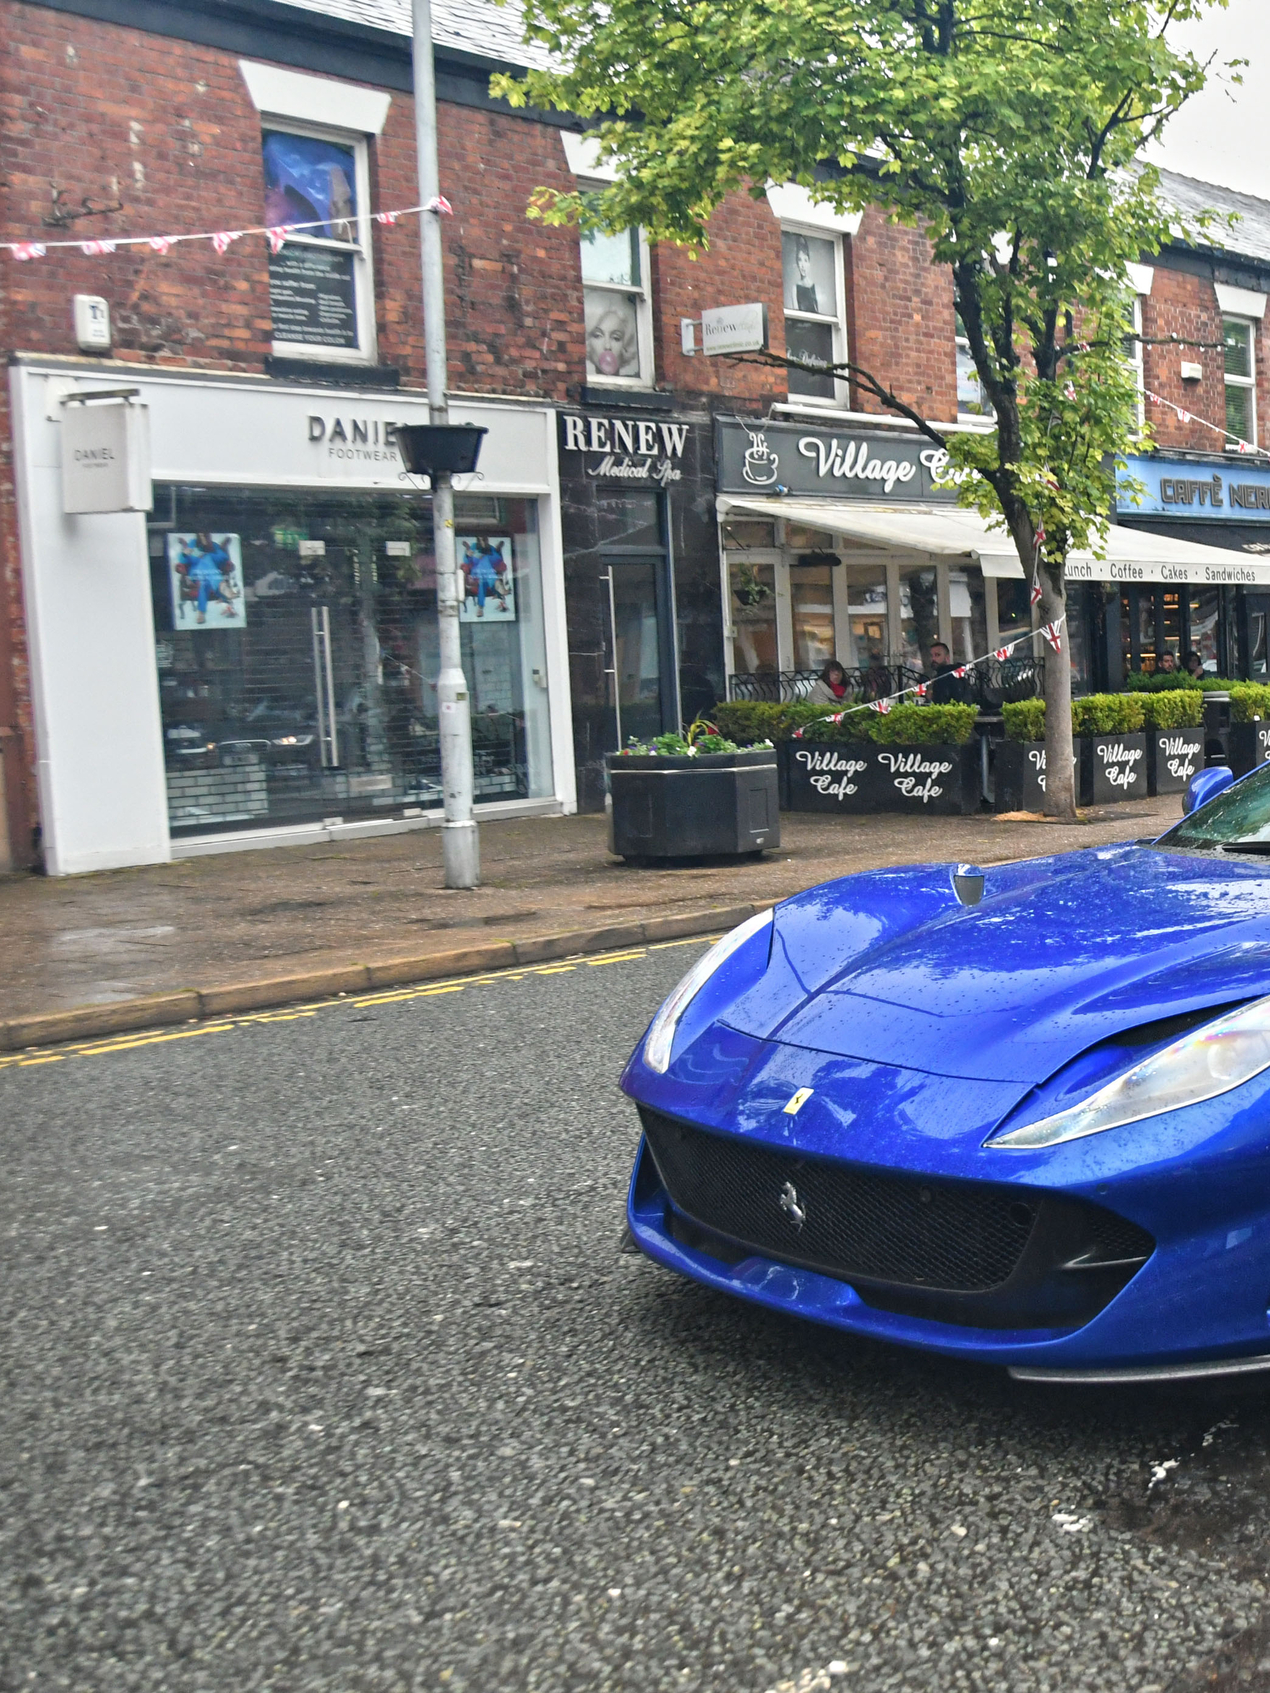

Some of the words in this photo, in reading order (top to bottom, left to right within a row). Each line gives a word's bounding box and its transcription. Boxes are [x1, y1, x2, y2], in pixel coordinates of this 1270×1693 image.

[307, 415, 402, 446] DANIE
[563, 415, 690, 459] RENEW
[75, 447, 115, 461] DANIEL
[328, 447, 398, 462] FOOTWEAR
[798, 437, 916, 494] Village
[587, 455, 649, 478] Medical
[652, 459, 682, 487] Spa
[1110, 562, 1144, 579] Coffee
[1161, 565, 1188, 580] Cakes
[1205, 567, 1256, 582] Sandwiches
[1097, 743, 1142, 767] Village
[1158, 736, 1201, 760] Village
[795, 750, 867, 777] Village
[877, 752, 952, 779] Village
[1167, 758, 1195, 782] Cafe
[809, 774, 858, 801] Cafe
[893, 776, 943, 804] Cafe
[1105, 765, 1137, 790] Cafe
